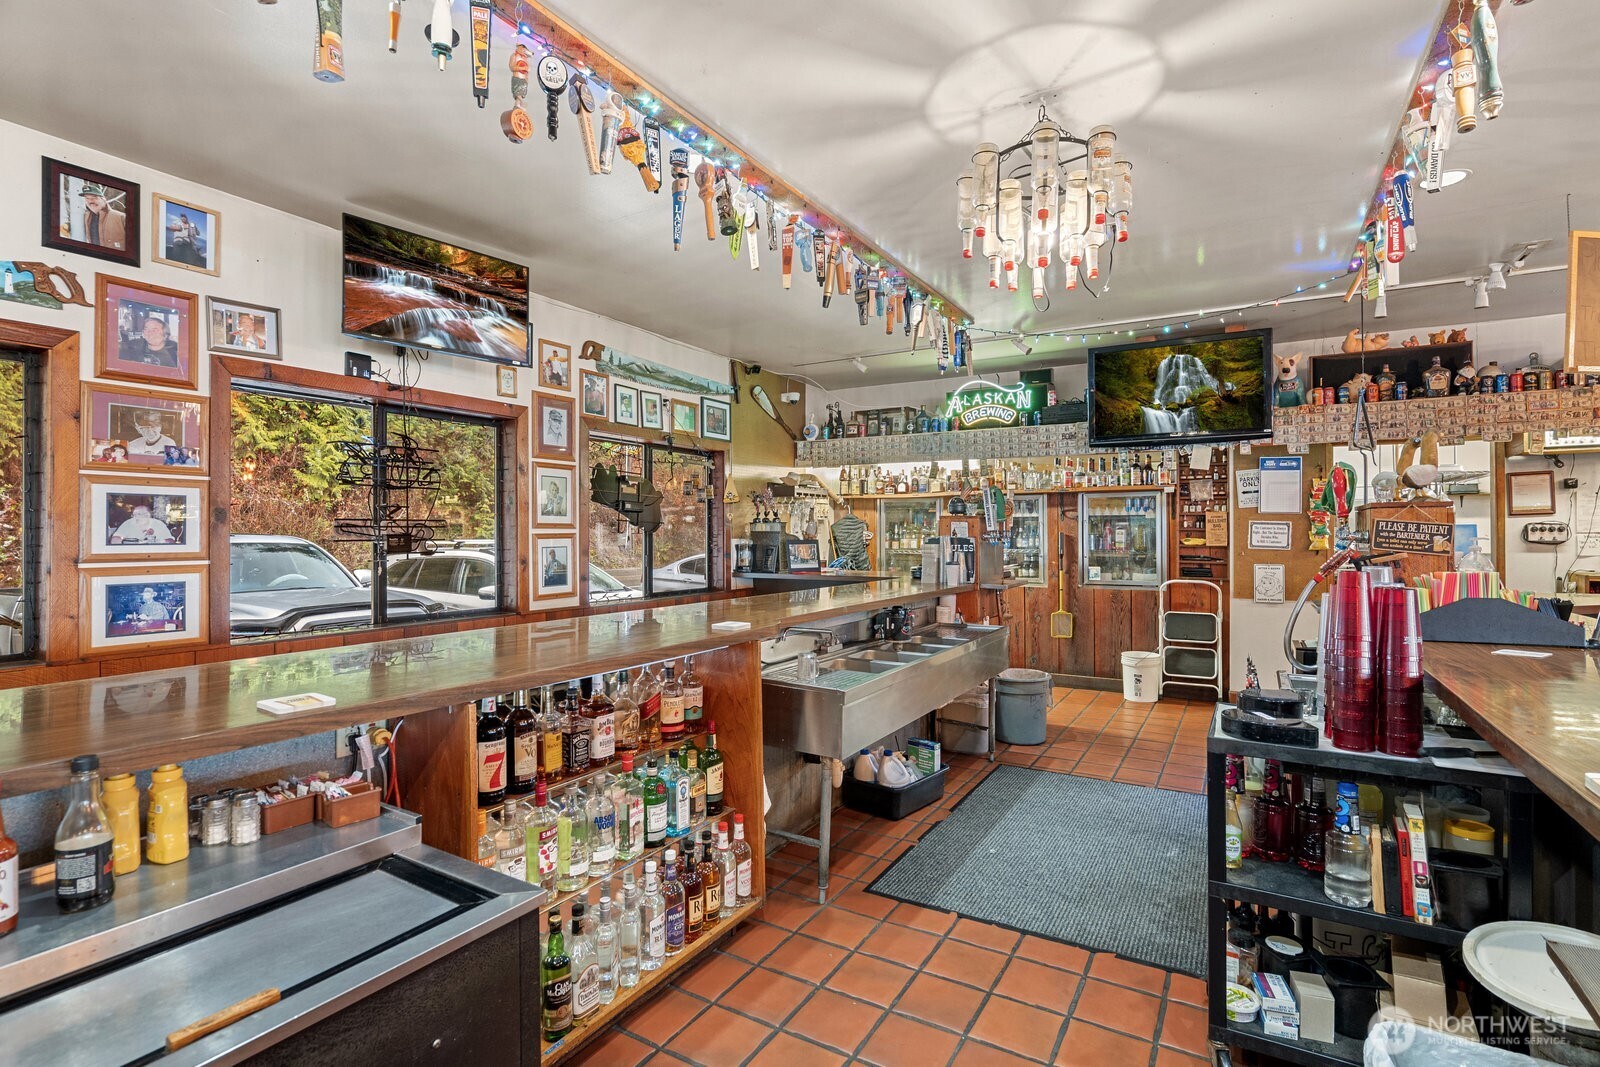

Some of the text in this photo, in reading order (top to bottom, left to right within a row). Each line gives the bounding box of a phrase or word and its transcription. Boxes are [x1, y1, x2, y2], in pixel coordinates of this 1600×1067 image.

[669, 151, 688, 159] SAMUEL
[1429, 151, 1439, 183] DAWGS!
[674, 204, 684, 240] LAGER
[1398, 204, 1406, 222] BUD
[1392, 220, 1400, 251] SNOW CAP
[945, 390, 1032, 418] ALASKAN
[964, 406, 1013, 424] BREWING
[1378, 521, 1450, 535] PLEASE BE PATIENT
[1396, 531, 1431, 541] BARTENDER
[951, 544, 974, 552] ULES
[487, 700, 495, 711] 7
[483, 751, 506, 790] 7
